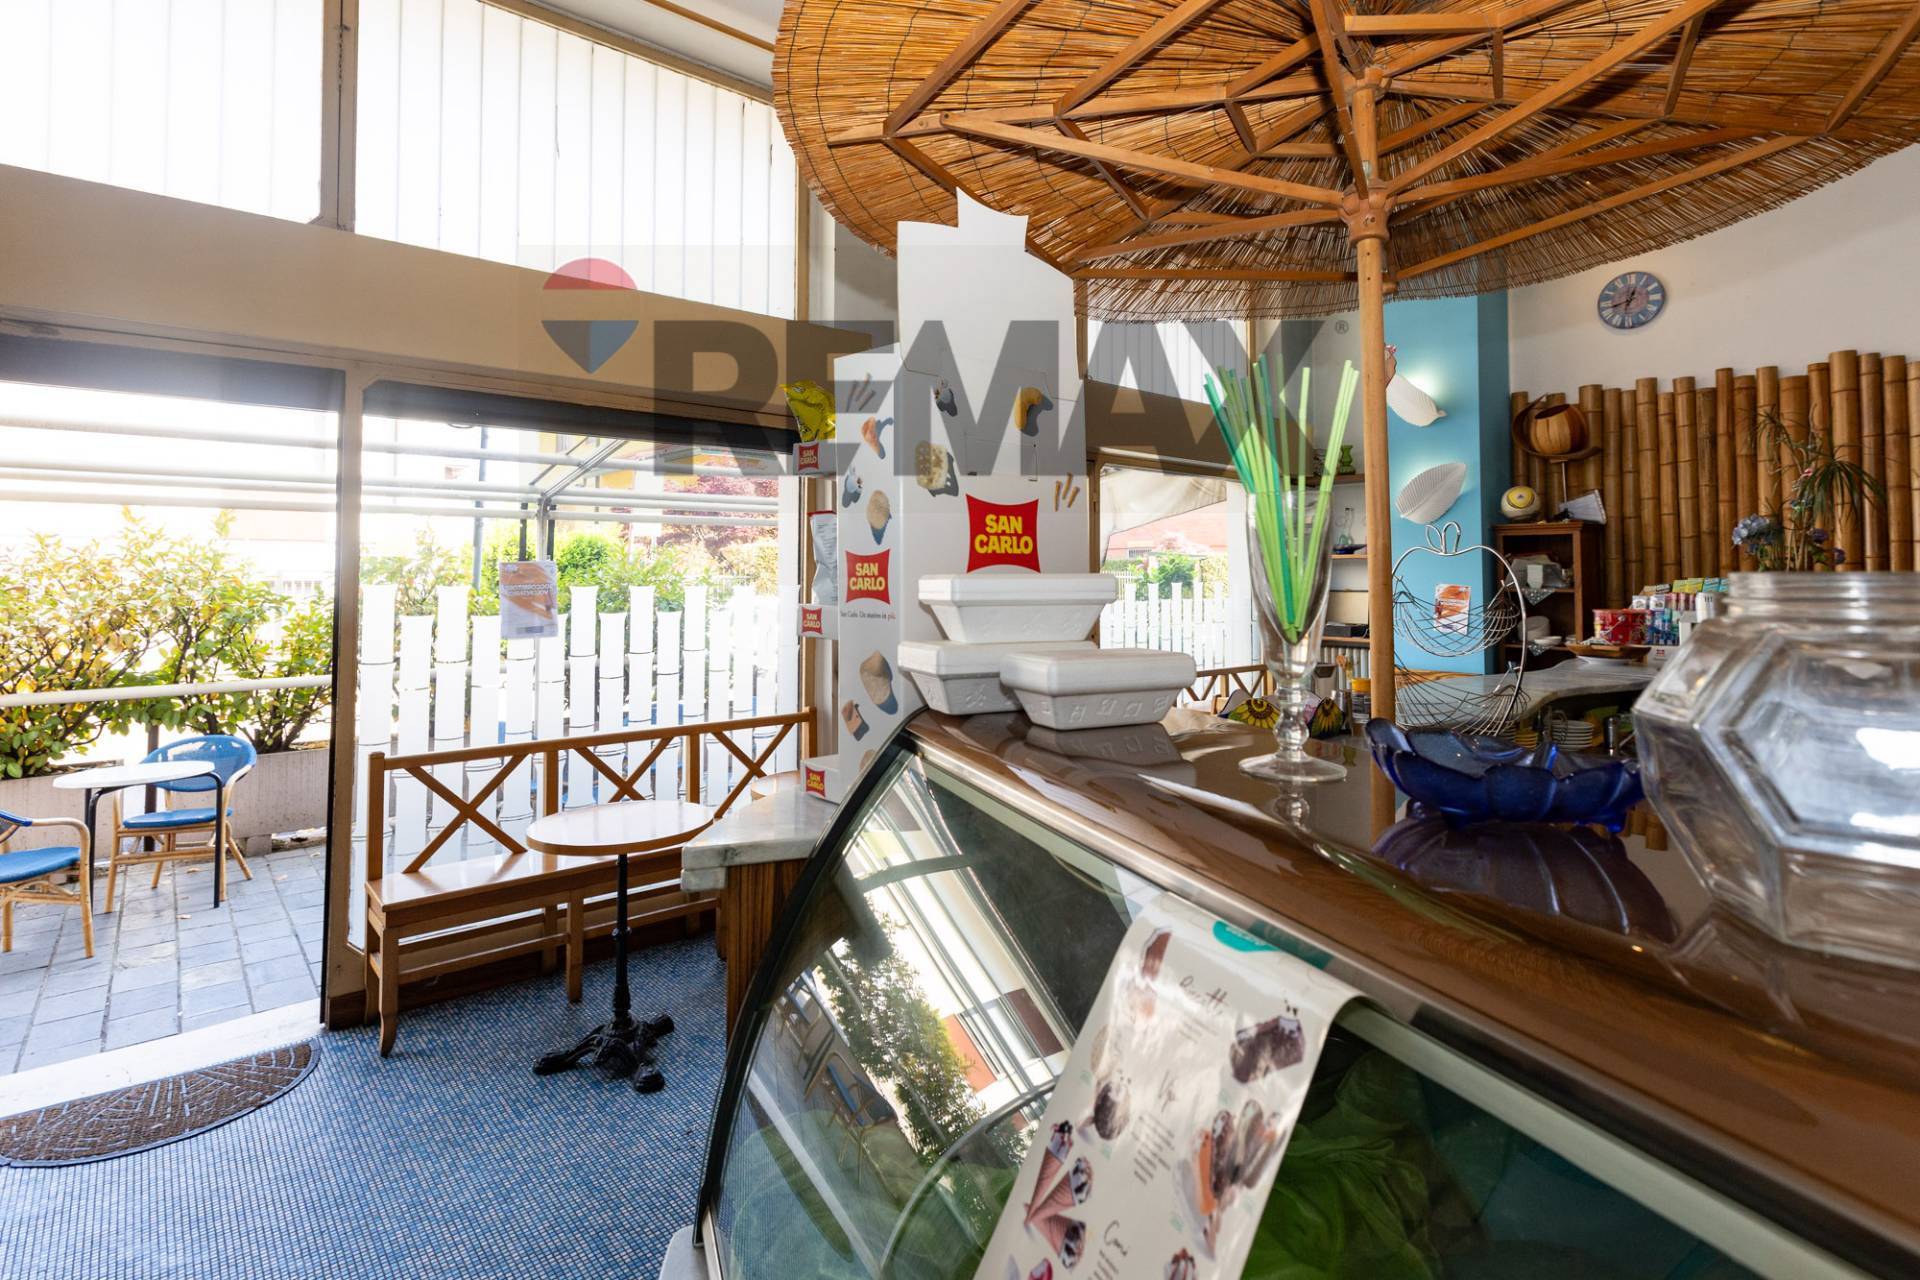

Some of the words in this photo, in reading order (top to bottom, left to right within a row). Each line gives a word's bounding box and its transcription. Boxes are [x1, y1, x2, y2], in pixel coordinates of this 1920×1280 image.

[985, 514, 1022, 534] SAN
[975, 534, 1033, 554] CARLO
[855, 562, 879, 576] SAN
[849, 576, 885, 591] CARLO
[804, 620, 820, 628] CARLO
